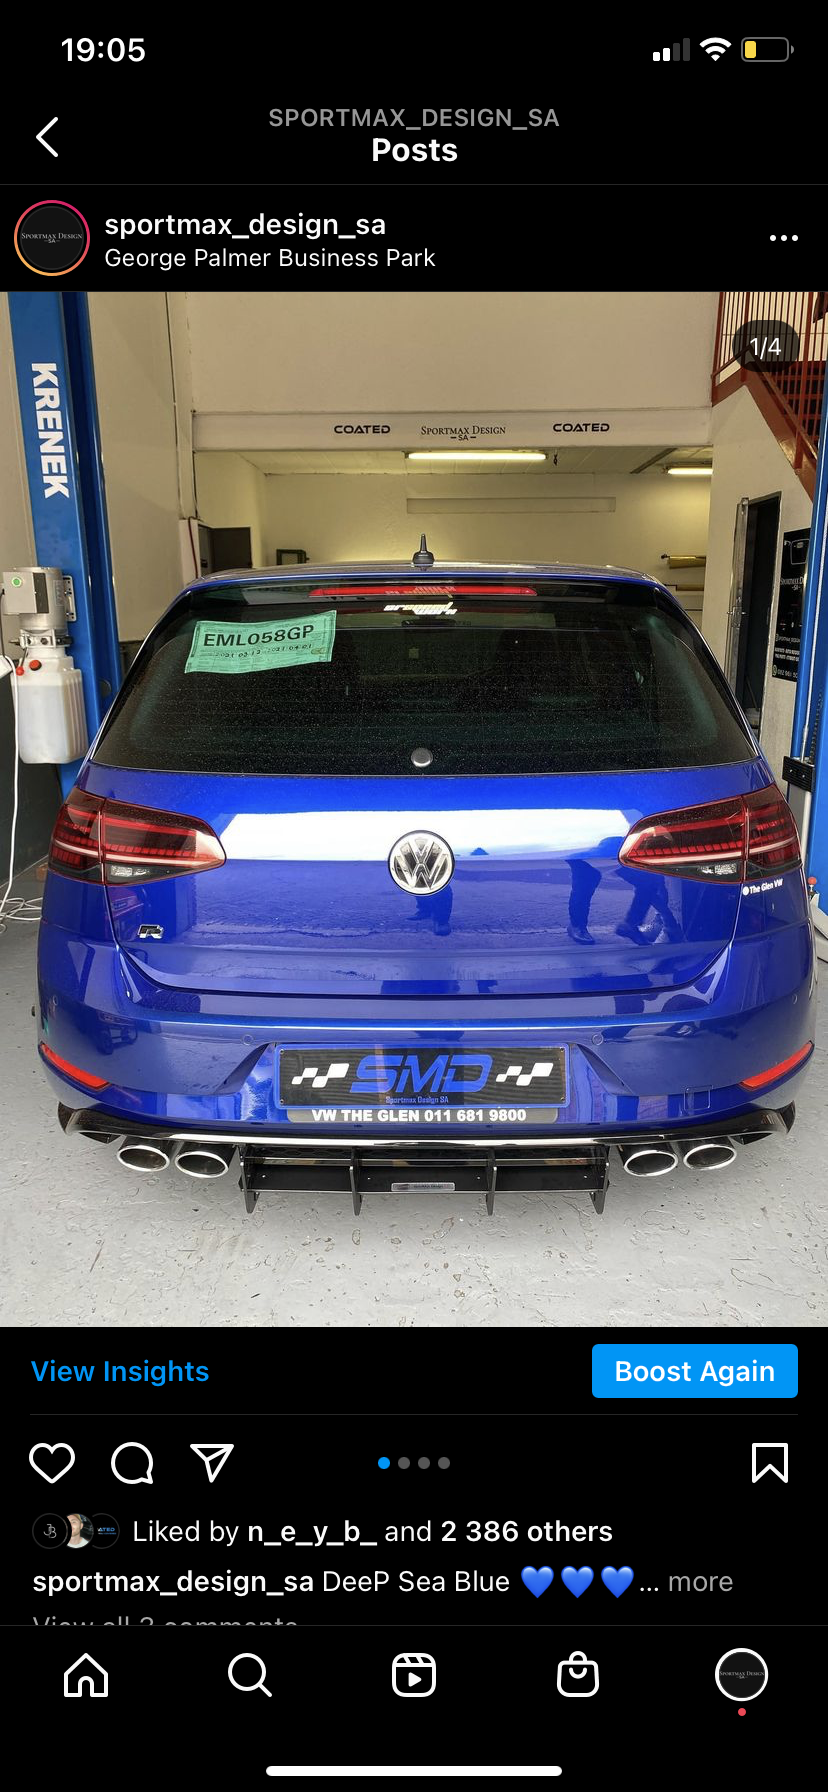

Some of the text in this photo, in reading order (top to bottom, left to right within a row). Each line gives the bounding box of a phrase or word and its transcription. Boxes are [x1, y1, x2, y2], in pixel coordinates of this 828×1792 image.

[31, 363, 70, 499] KRENEK
[333, 424, 391, 434] COATED
[552, 422, 610, 433] COATED
[203, 624, 315, 647] EML058GP
[349, 1054, 494, 1094] SMD
[311, 1109, 527, 1122] VW THE GLEN 011 681 9800
